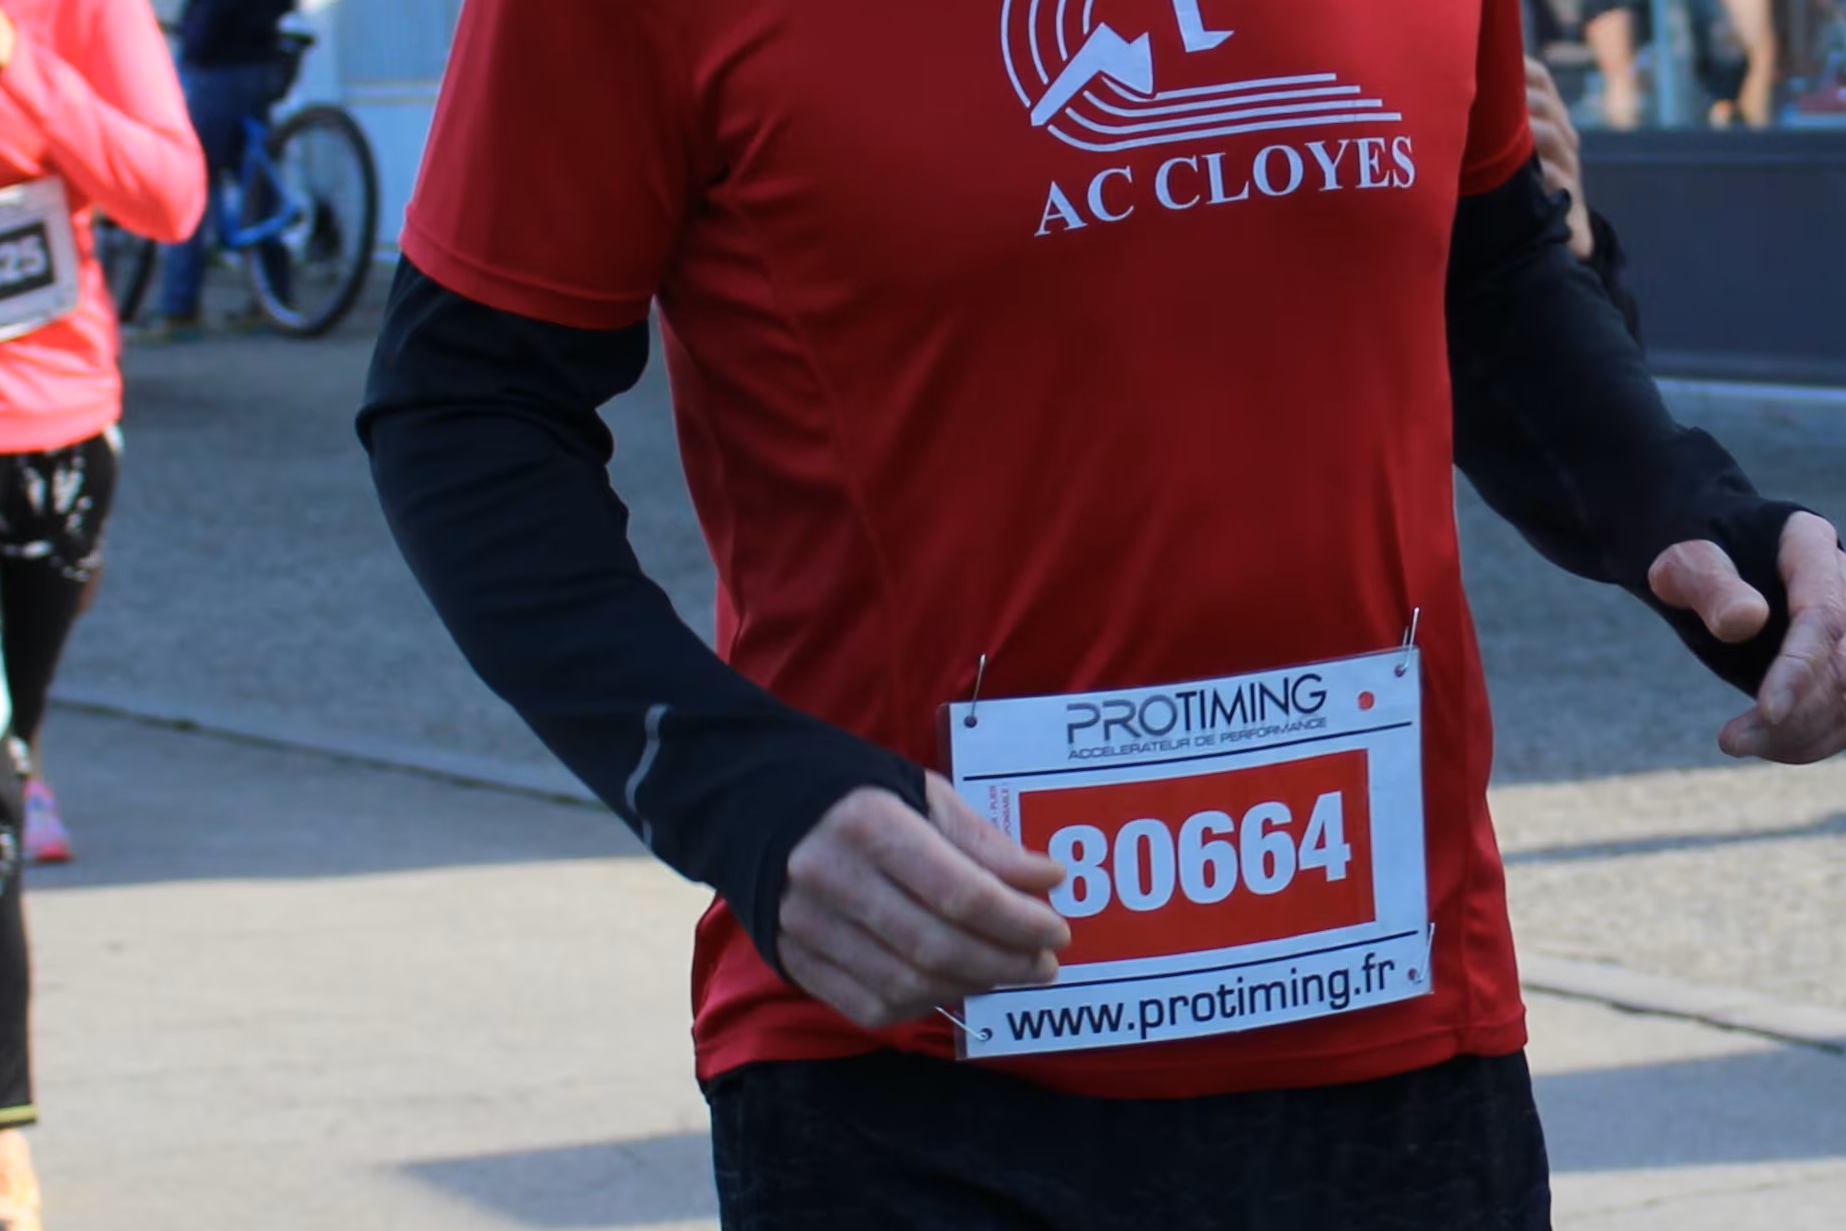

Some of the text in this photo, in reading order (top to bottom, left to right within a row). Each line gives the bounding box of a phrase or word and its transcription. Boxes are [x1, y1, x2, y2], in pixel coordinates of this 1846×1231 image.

[1033, 135, 1416, 237] AC CLOYES
[1066, 673, 1328, 745] PROTIMING
[1068, 717, 1328, 761] ACCELERATEUR DE PERFORMANCE
[1048, 791, 1352, 918] 80664
[1006, 951, 1396, 1042] www.protiming.fr
